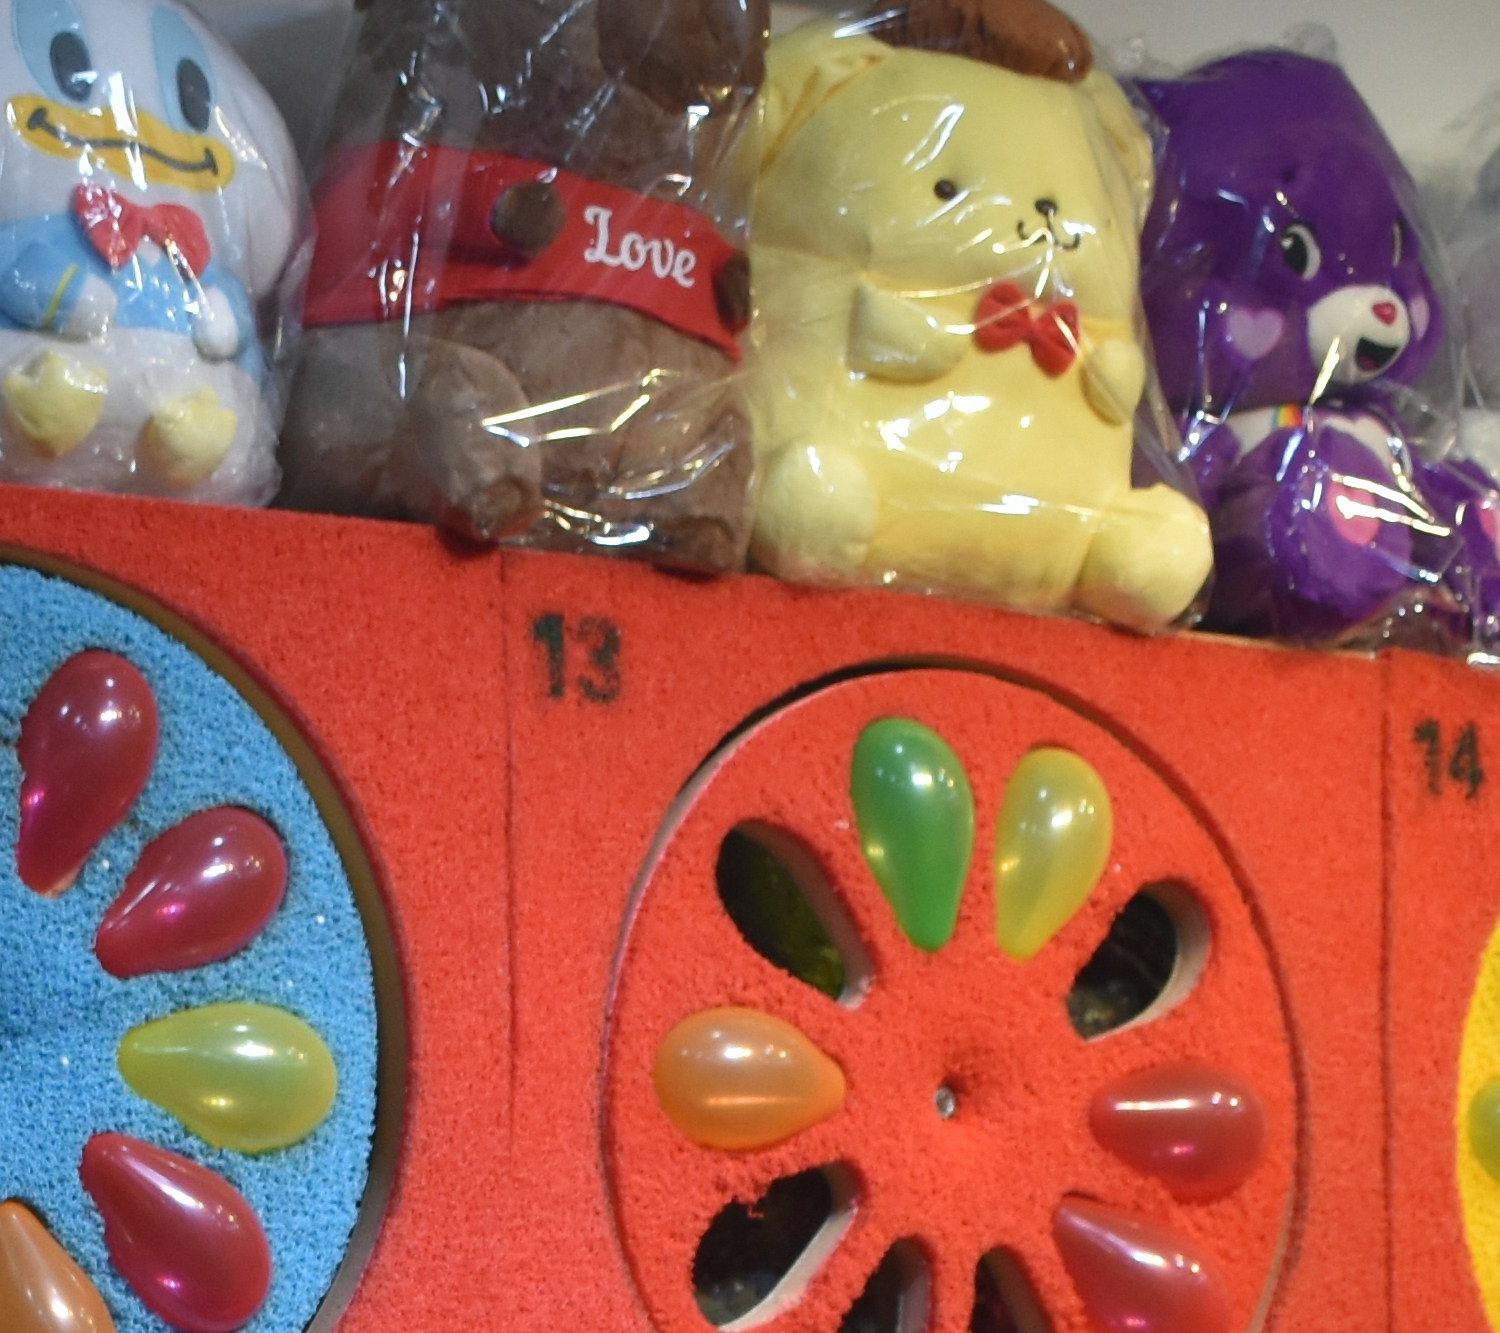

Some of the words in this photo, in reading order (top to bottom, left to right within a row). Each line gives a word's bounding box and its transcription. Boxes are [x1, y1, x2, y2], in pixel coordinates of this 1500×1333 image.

[583, 205, 697, 288] Love
[533, 613, 621, 702] 13
[1414, 718, 1484, 800] 14
